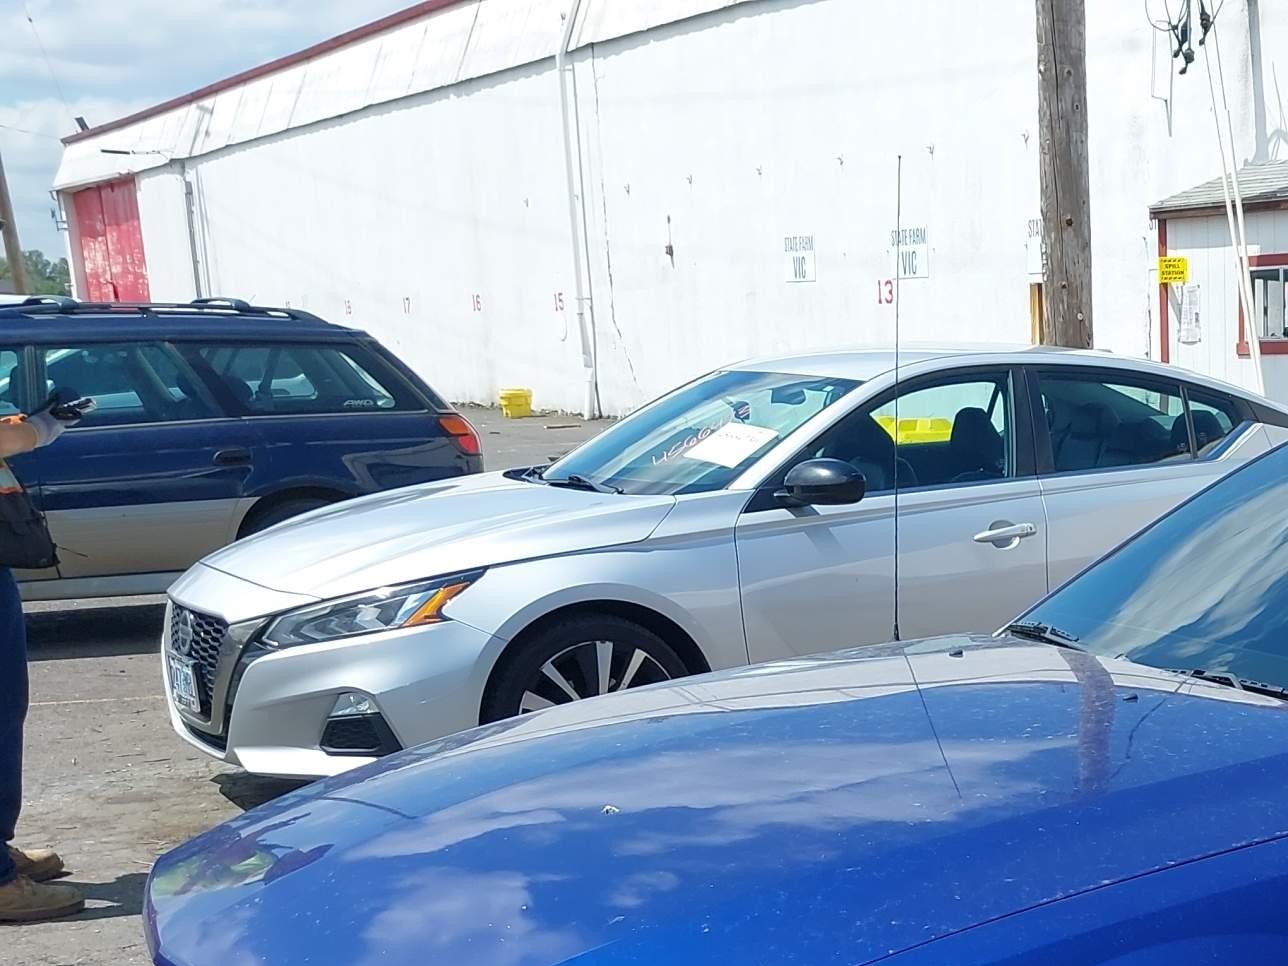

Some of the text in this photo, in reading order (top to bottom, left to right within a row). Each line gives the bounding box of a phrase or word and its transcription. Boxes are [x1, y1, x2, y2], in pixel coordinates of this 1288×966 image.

[784, 234, 814, 252] STATE FARM
[909, 227, 927, 245] FARM
[793, 255, 807, 279] VIC
[901, 250, 917, 276] VIC
[877, 279, 894, 304] 13
[471, 293, 481, 312] 16
[553, 292, 565, 312] 15
